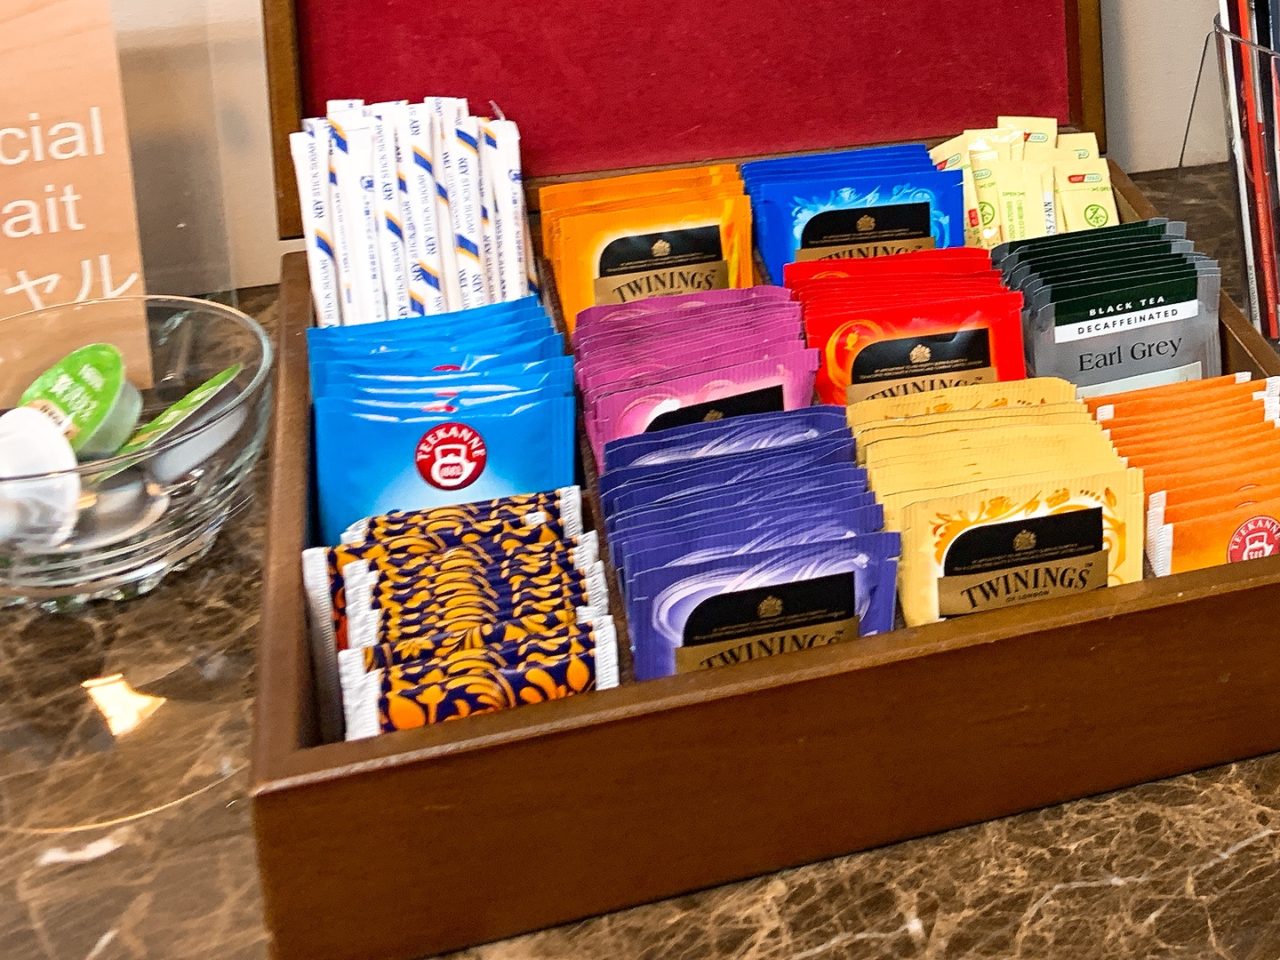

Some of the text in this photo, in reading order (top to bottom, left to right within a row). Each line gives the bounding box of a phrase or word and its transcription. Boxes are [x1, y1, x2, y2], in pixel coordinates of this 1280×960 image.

[0, 106, 105, 166] cial
[379, 154, 391, 179] STICK
[457, 157, 470, 176] KEY
[309, 171, 322, 197] STICK
[382, 182, 394, 201] KEY
[1, 183, 87, 239] ait
[312, 200, 325, 219] KEY
[420, 205, 432, 233] STICK
[424, 236, 437, 256] KEY
[410, 262, 423, 282] KEY
[612, 271, 715, 303] TWININGS
[1089, 295, 1165, 317] BLACK TEA
[1077, 308, 1179, 335] DECAFFEINATED
[1079, 337, 1182, 372] Earl Grey
[416, 425, 487, 462] TEEKANNE
[960, 566, 1091, 609] TWININGS
[1005, 590, 1050, 603] OF LONDON
